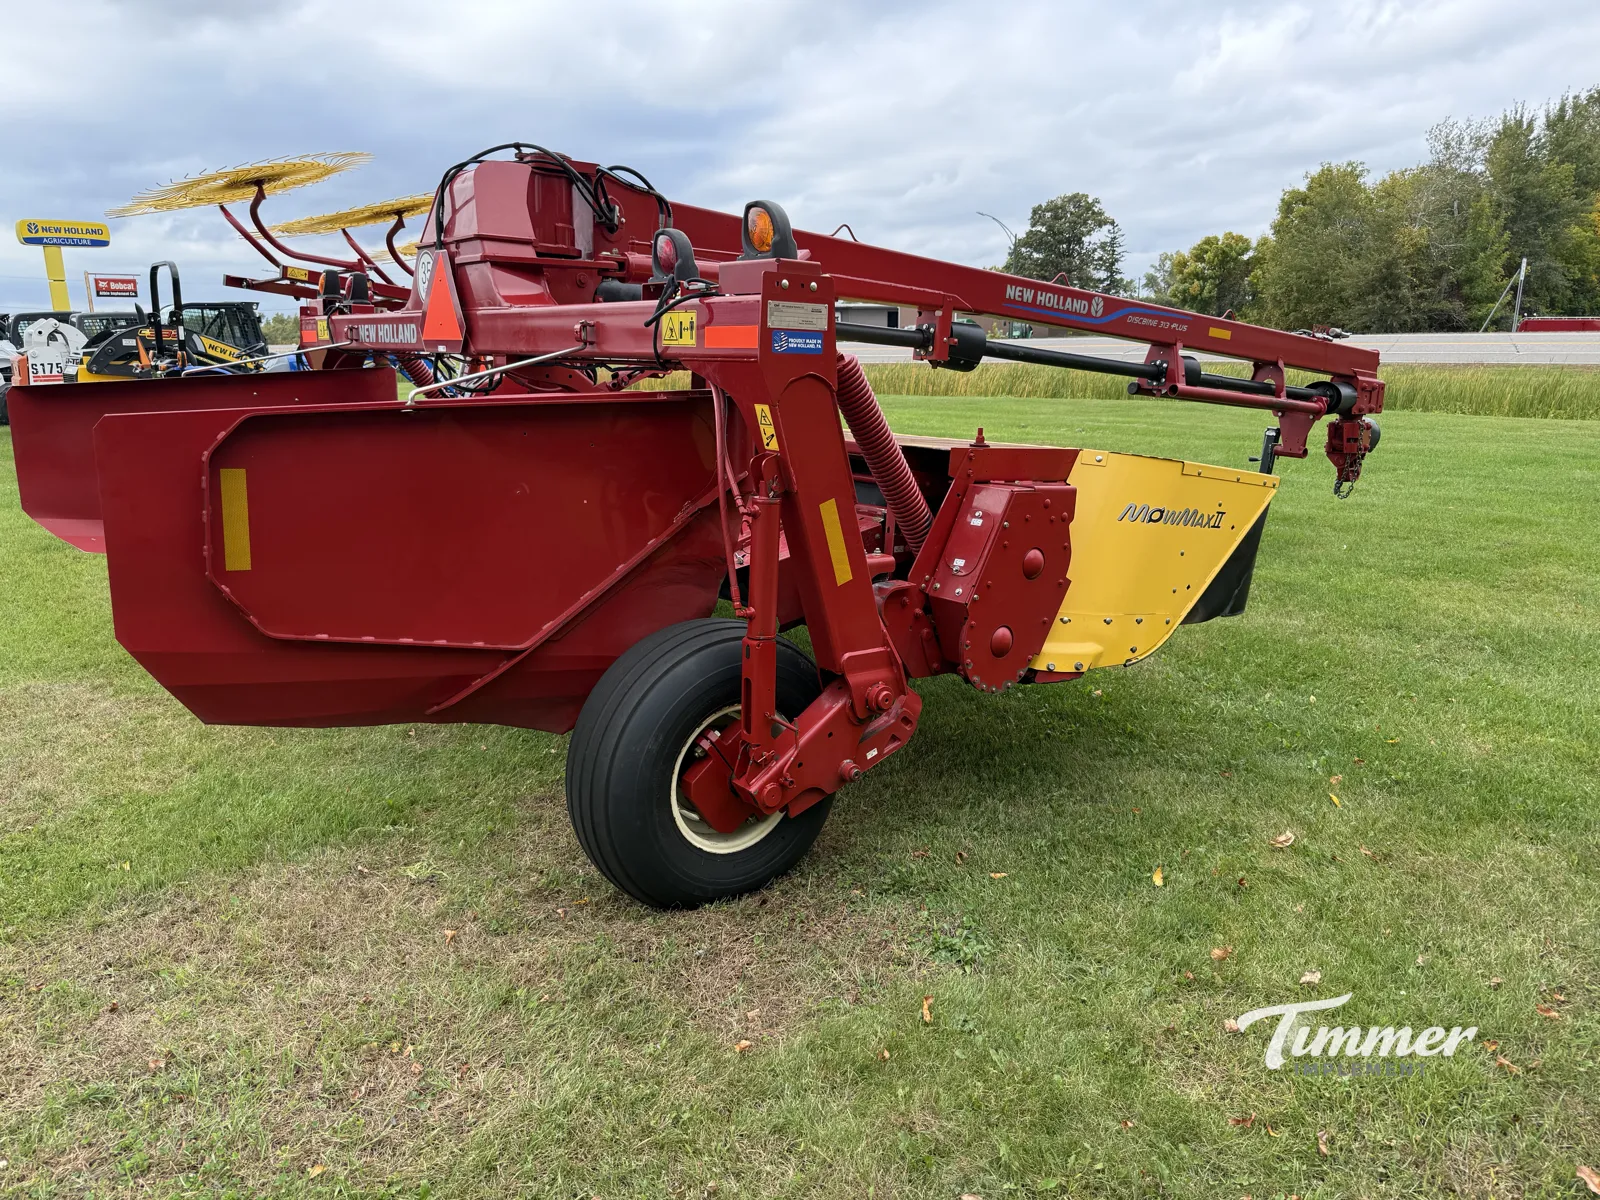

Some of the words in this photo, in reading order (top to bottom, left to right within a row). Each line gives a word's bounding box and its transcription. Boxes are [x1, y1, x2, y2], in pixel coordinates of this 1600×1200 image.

[41, 225, 62, 234] NEW
[64, 227, 104, 236] HOLLAND
[43, 237, 92, 246] AGRICULTURE
[110, 281, 134, 290] Bobcat
[1005, 284, 1035, 302] NEW
[1036, 291, 1089, 315] HOLLAND
[1126, 315, 1159, 327] DISCBINE
[1158, 321, 1170, 329] 313
[359, 324, 376, 343] NEW
[378, 323, 417, 344] HOLLAND
[208, 343, 228, 354] NEW
[31, 362, 63, 375] S175
